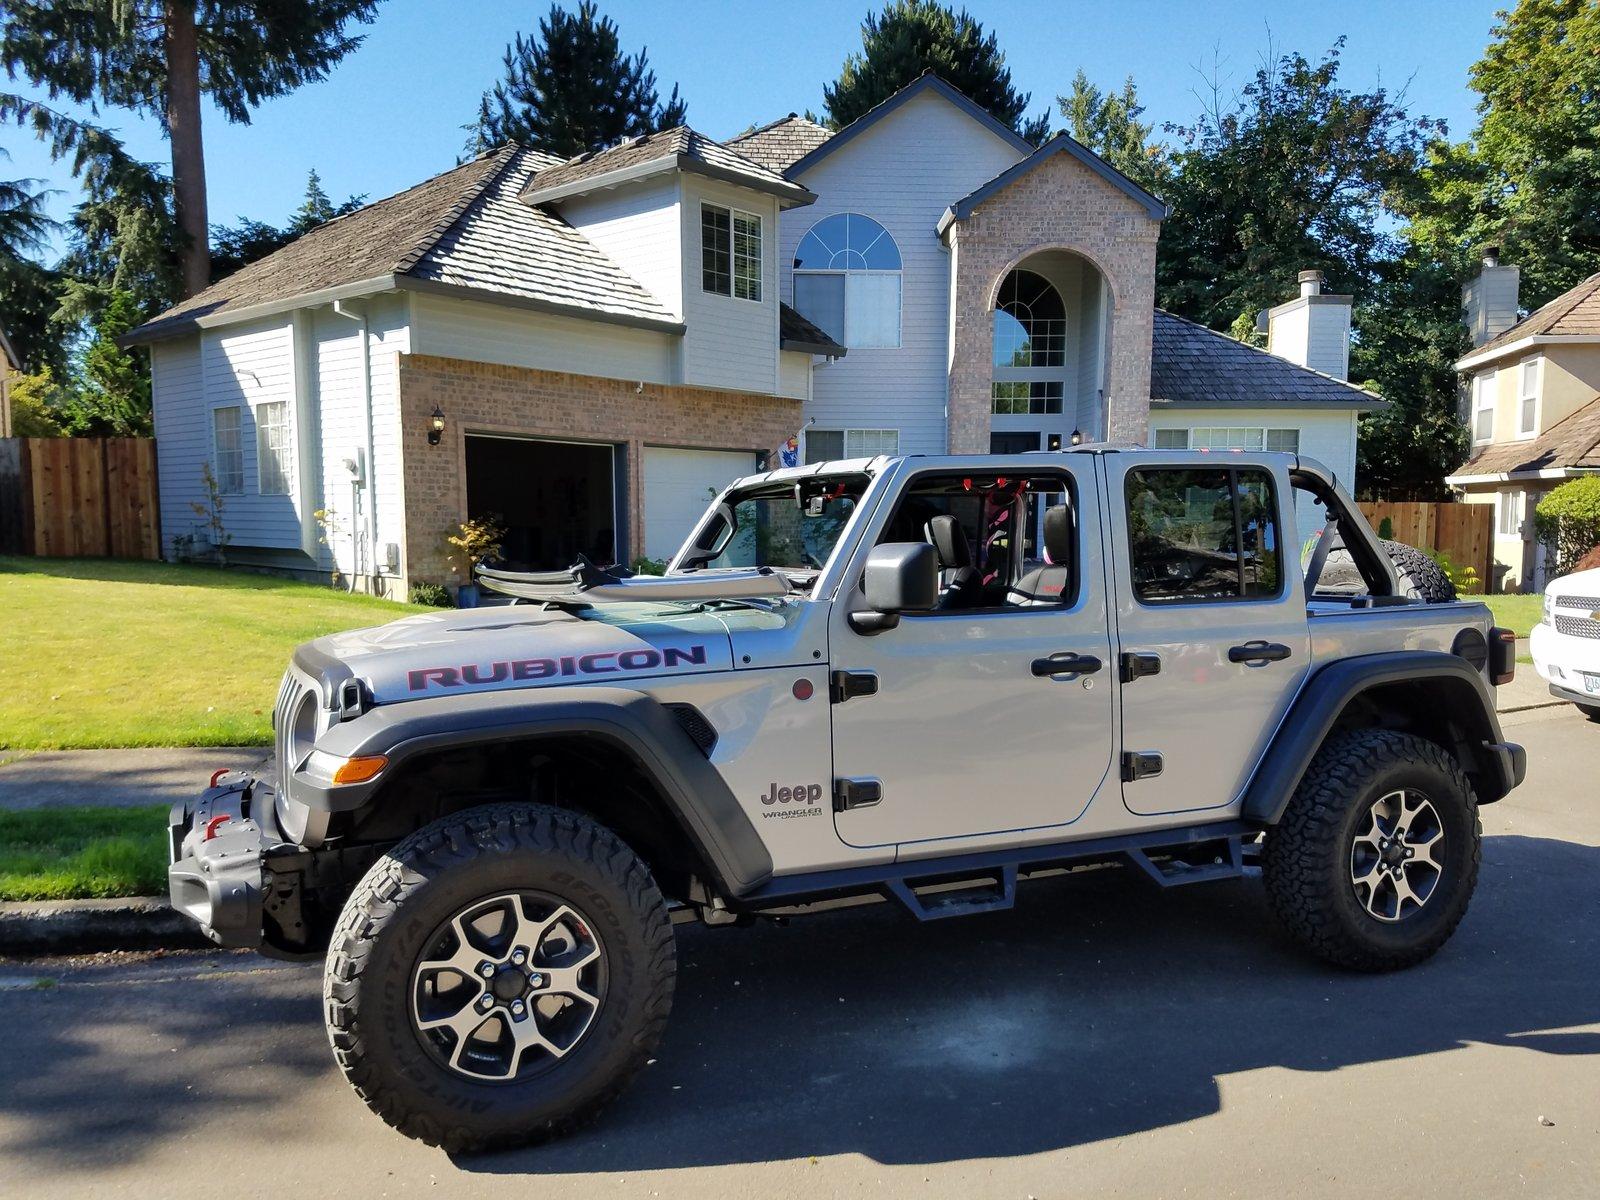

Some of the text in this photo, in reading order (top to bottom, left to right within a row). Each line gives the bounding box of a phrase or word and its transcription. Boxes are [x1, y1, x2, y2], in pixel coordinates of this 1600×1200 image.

[407, 645, 707, 691] RUBICON
[760, 782, 822, 805] Jeep
[762, 807, 822, 819] WRANGLER
